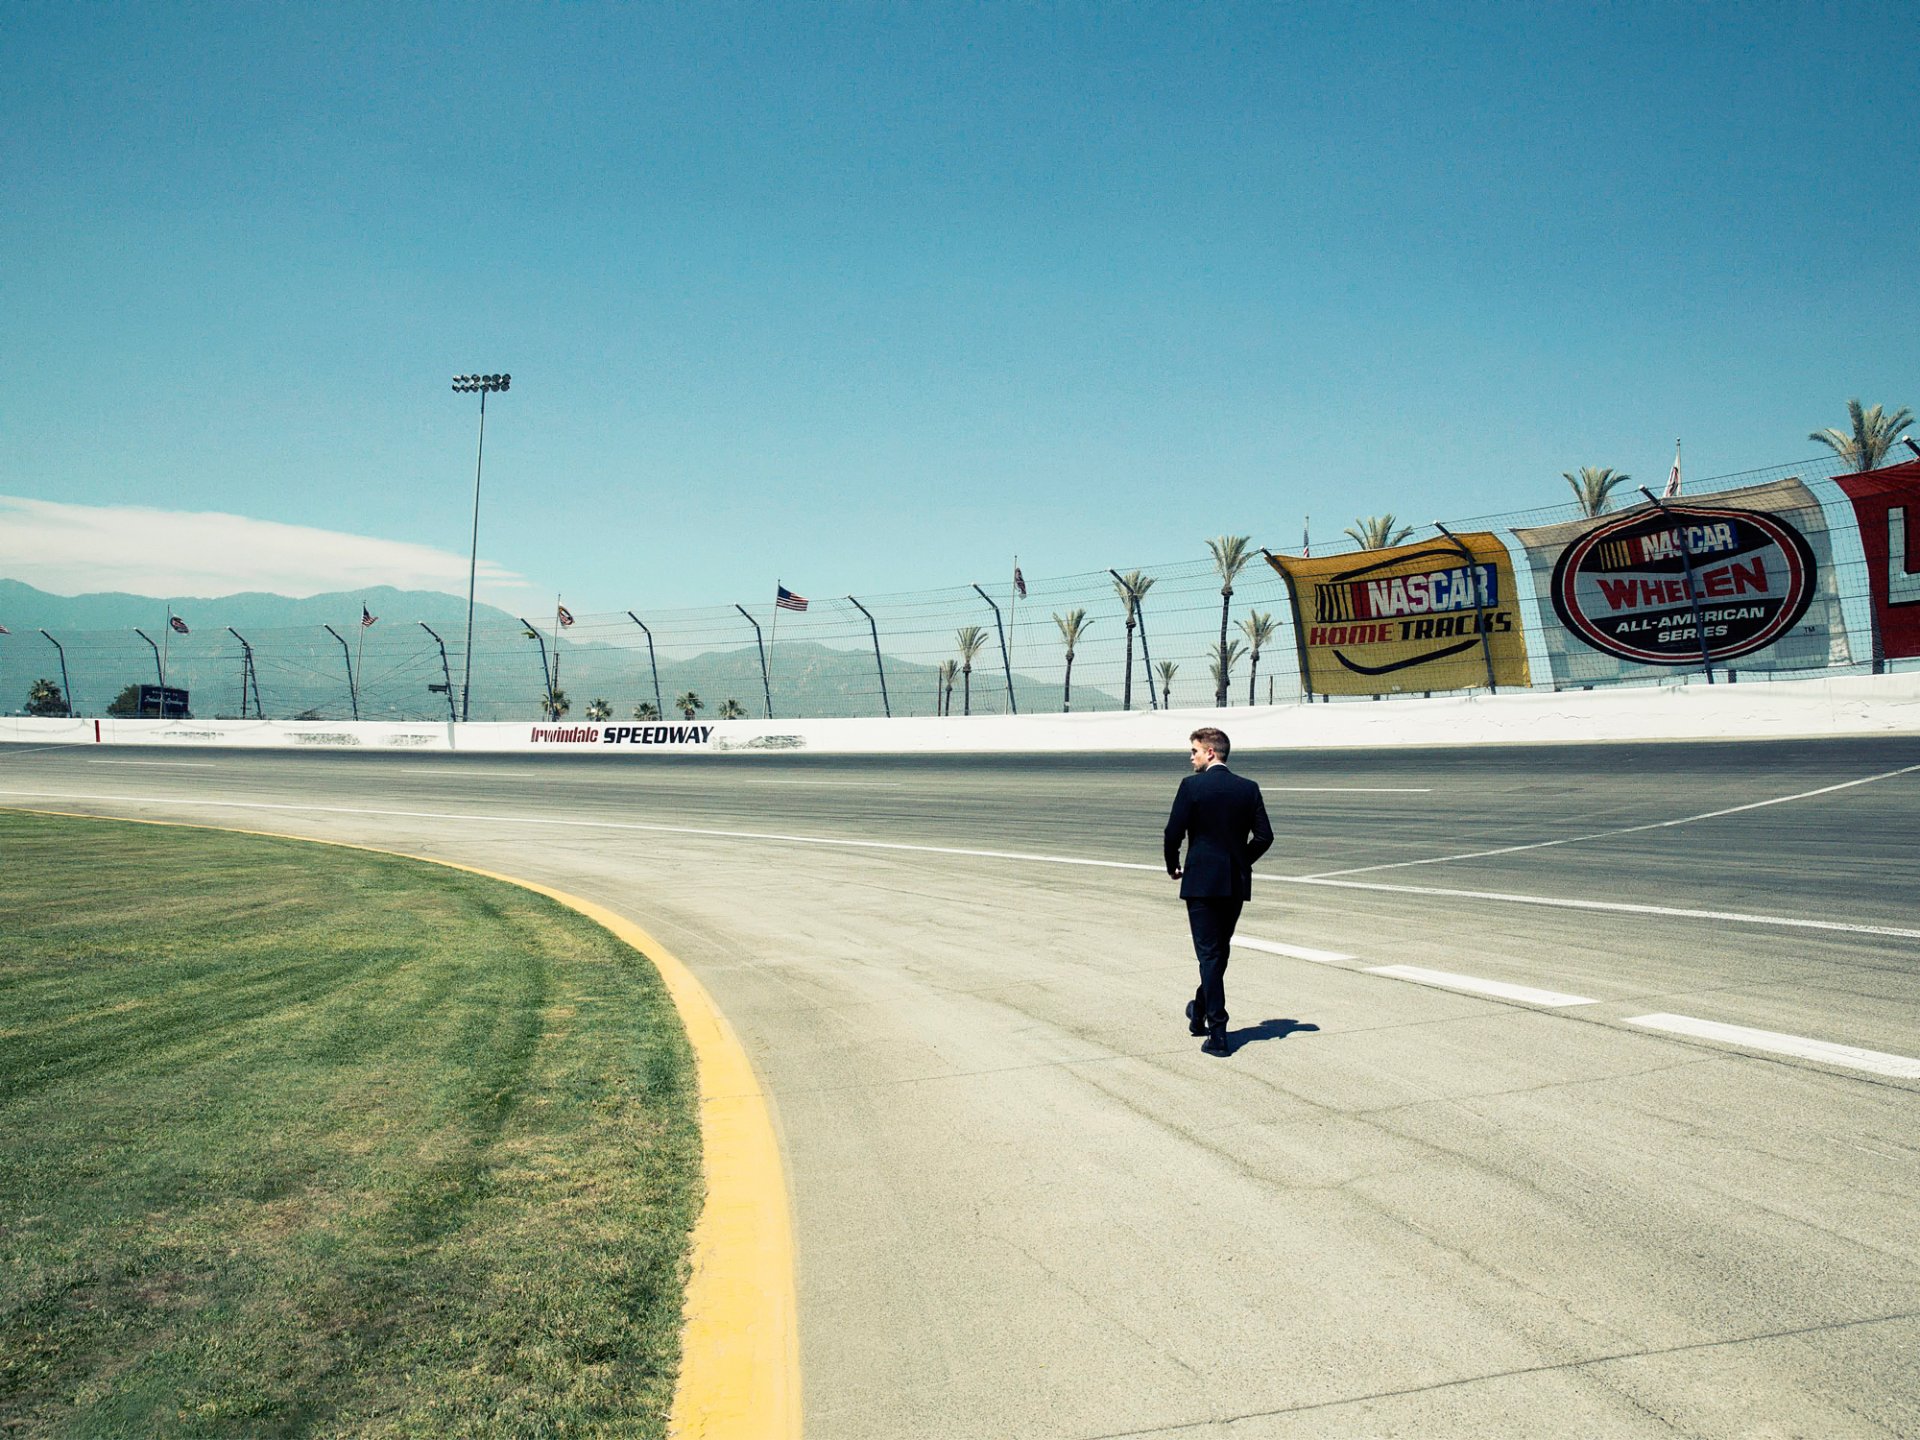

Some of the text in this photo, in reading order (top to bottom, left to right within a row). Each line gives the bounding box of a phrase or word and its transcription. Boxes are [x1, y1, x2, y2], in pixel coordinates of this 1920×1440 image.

[1640, 523, 1734, 562] NASCAR
[1367, 565, 1488, 618] NASCAR
[1596, 556, 1769, 610] WHELEN
[1309, 611, 1512, 646] HOME TRACKS
[1615, 606, 1765, 634] ALL-AMERICAN
[530, 726, 599, 743] Irwindale
[603, 725, 715, 744] SPEEDWAY
